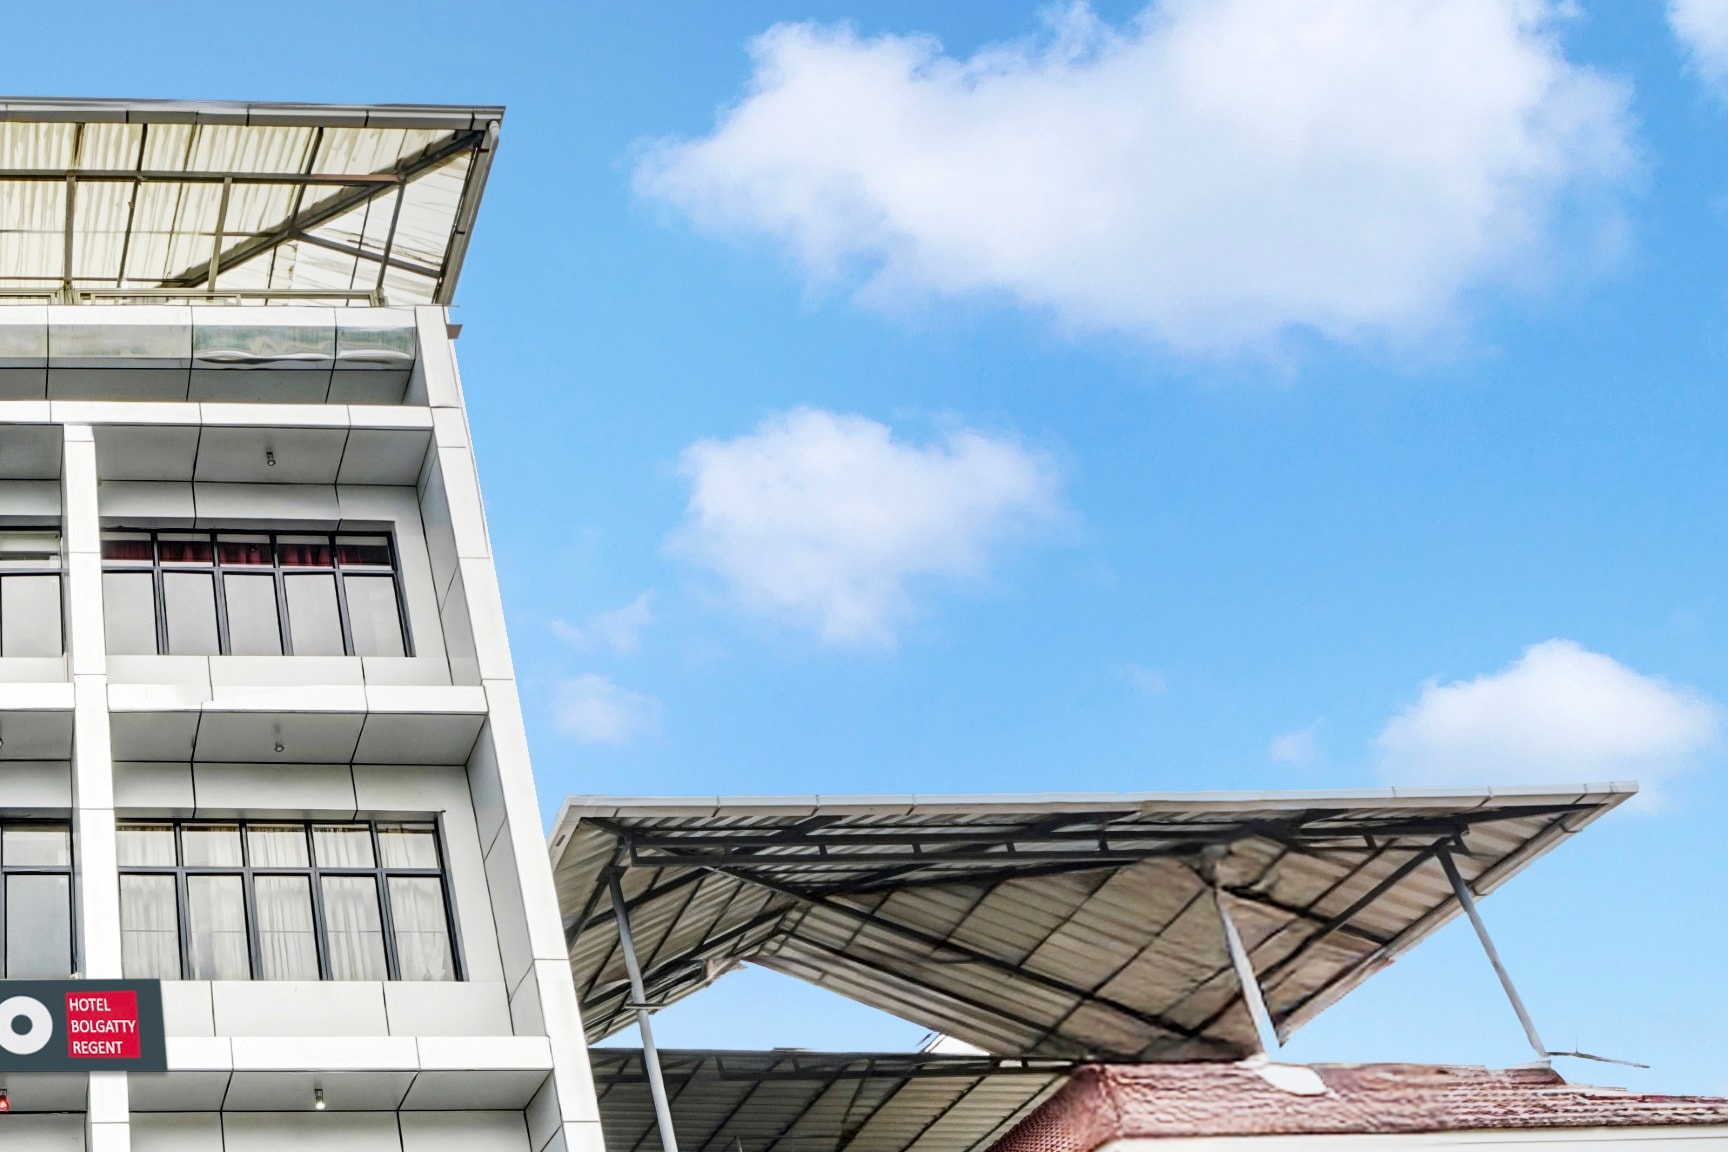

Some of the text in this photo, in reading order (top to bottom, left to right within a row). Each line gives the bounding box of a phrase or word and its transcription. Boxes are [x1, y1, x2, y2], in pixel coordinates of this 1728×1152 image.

[69, 998, 112, 1012] HOTEL
[71, 1019, 136, 1033] BOLGATTY
[73, 1041, 123, 1055] REGENT
